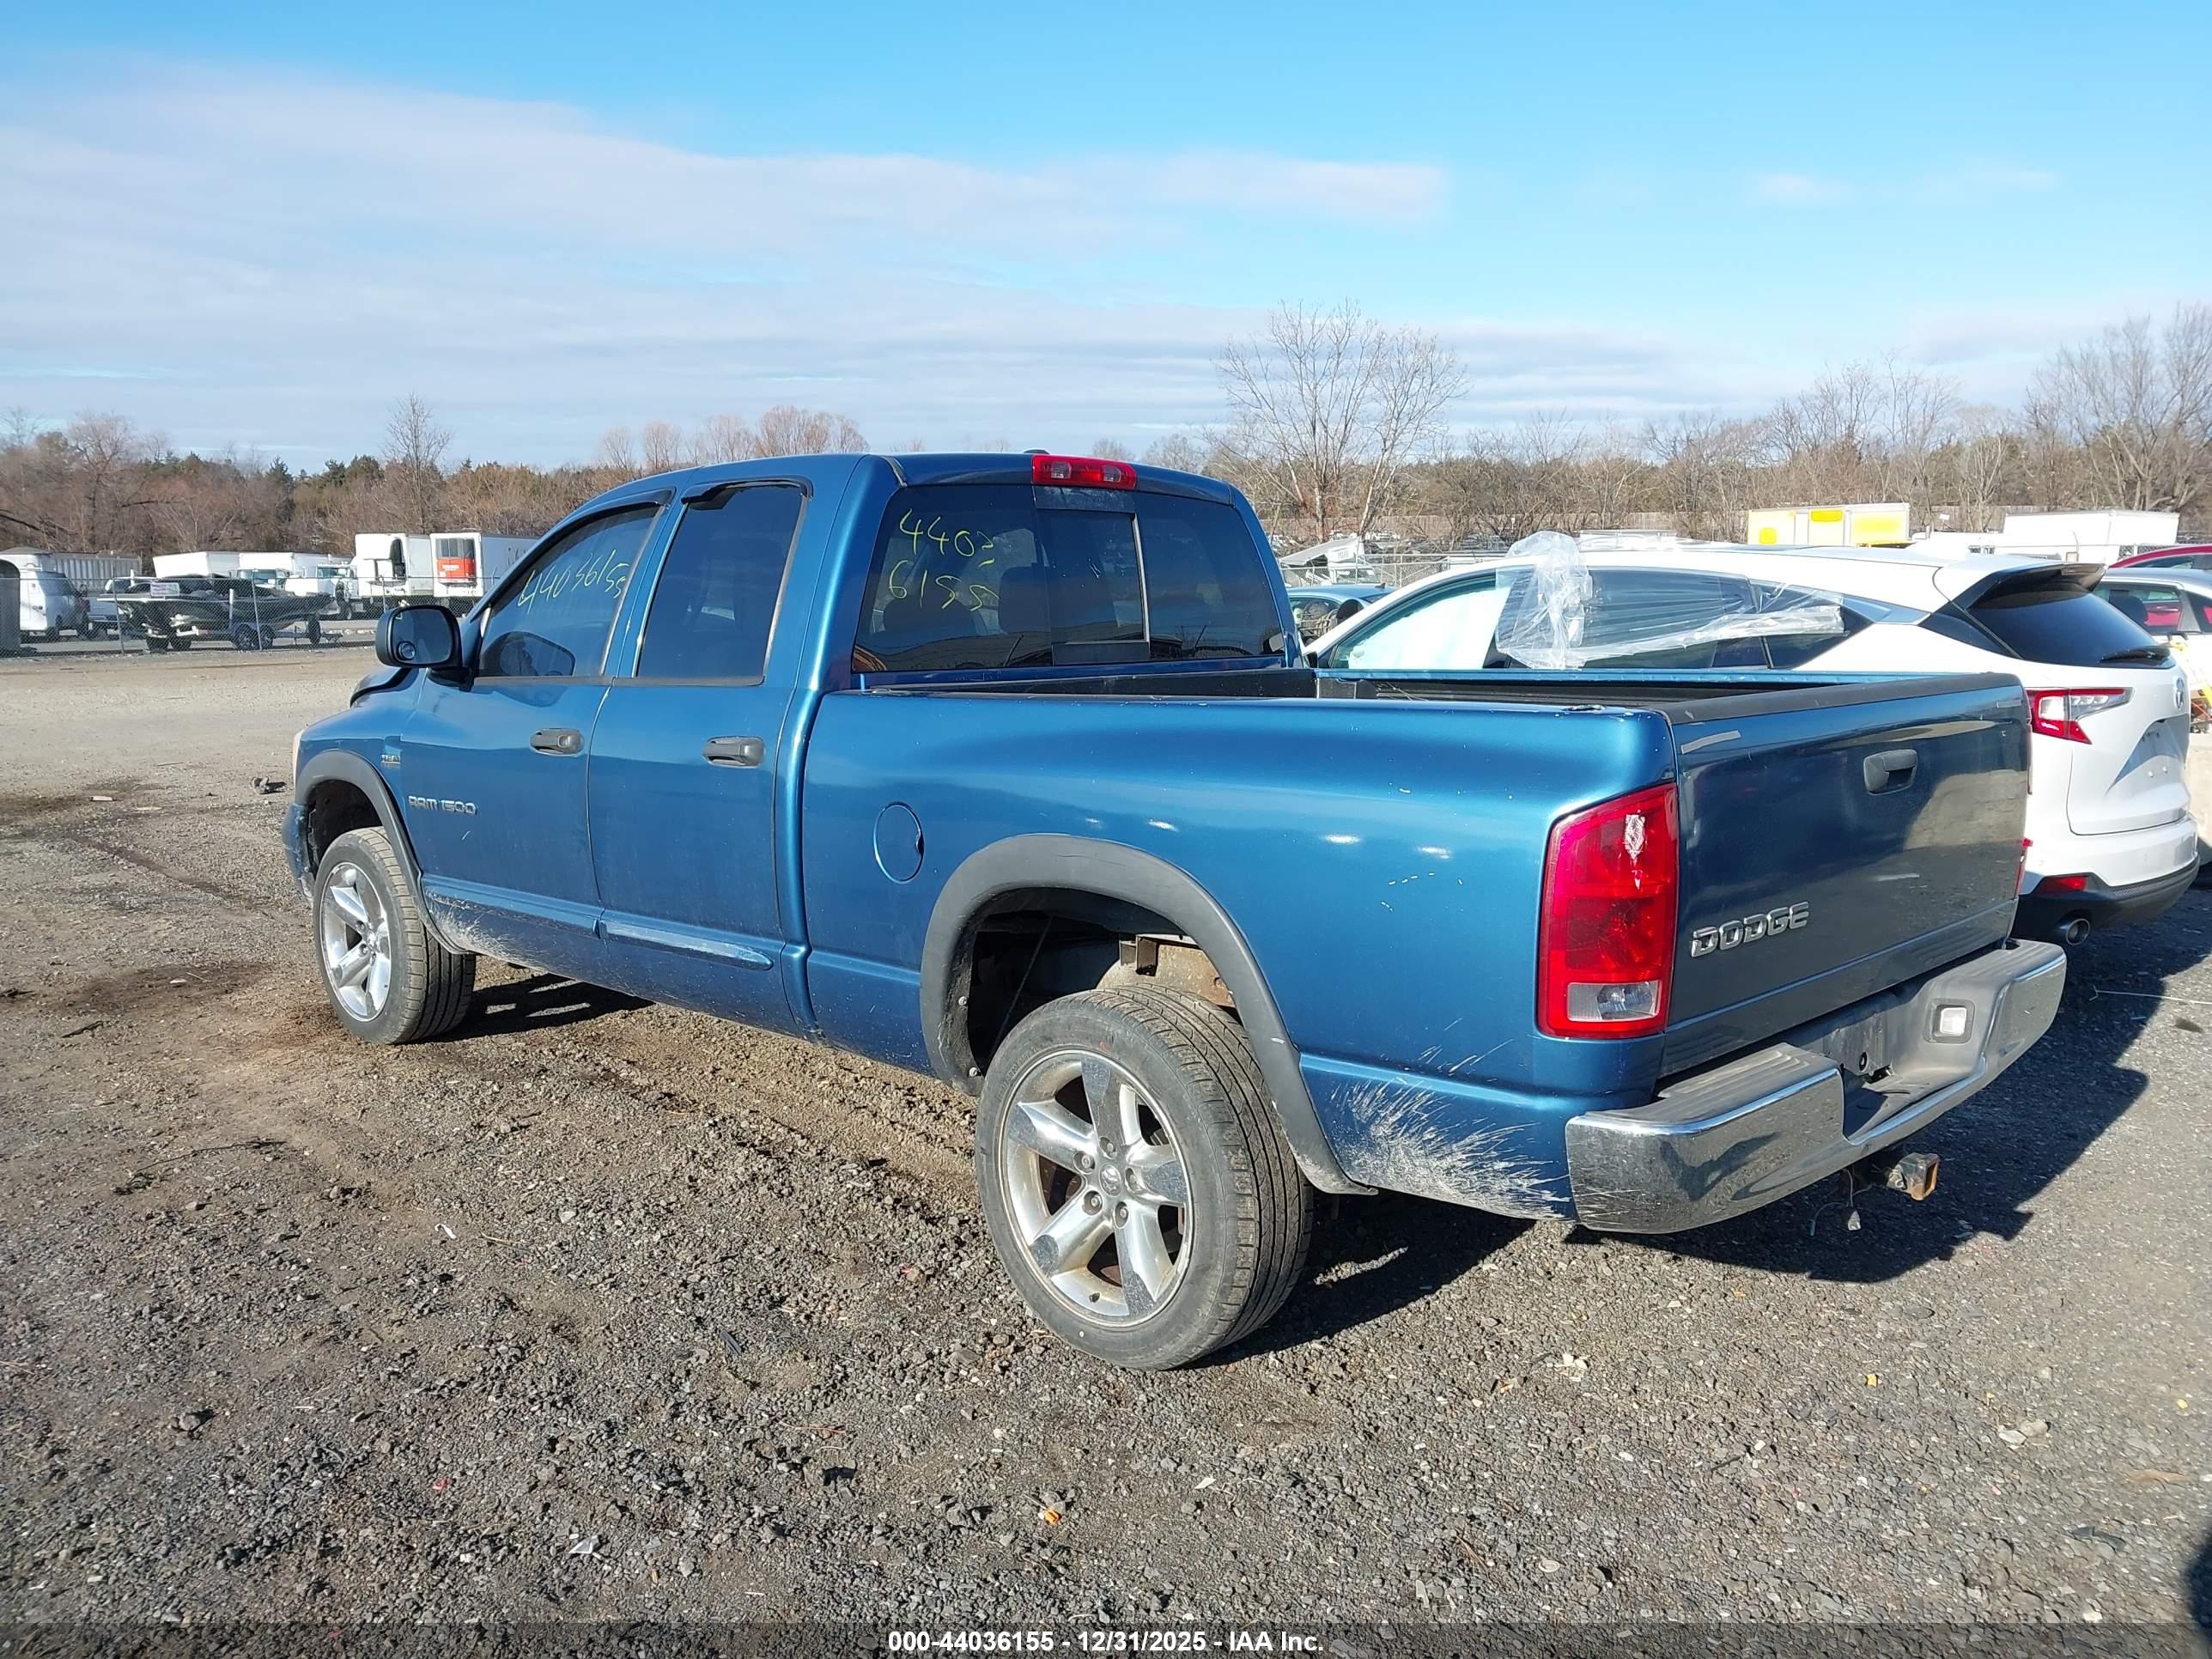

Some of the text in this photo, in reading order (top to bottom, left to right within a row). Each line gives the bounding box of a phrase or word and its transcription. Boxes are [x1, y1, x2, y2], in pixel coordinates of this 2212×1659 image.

[888, 559, 1000, 611] 6155
[408, 795, 477, 816] RAM 1500
[1691, 901, 1810, 958] DODGE
